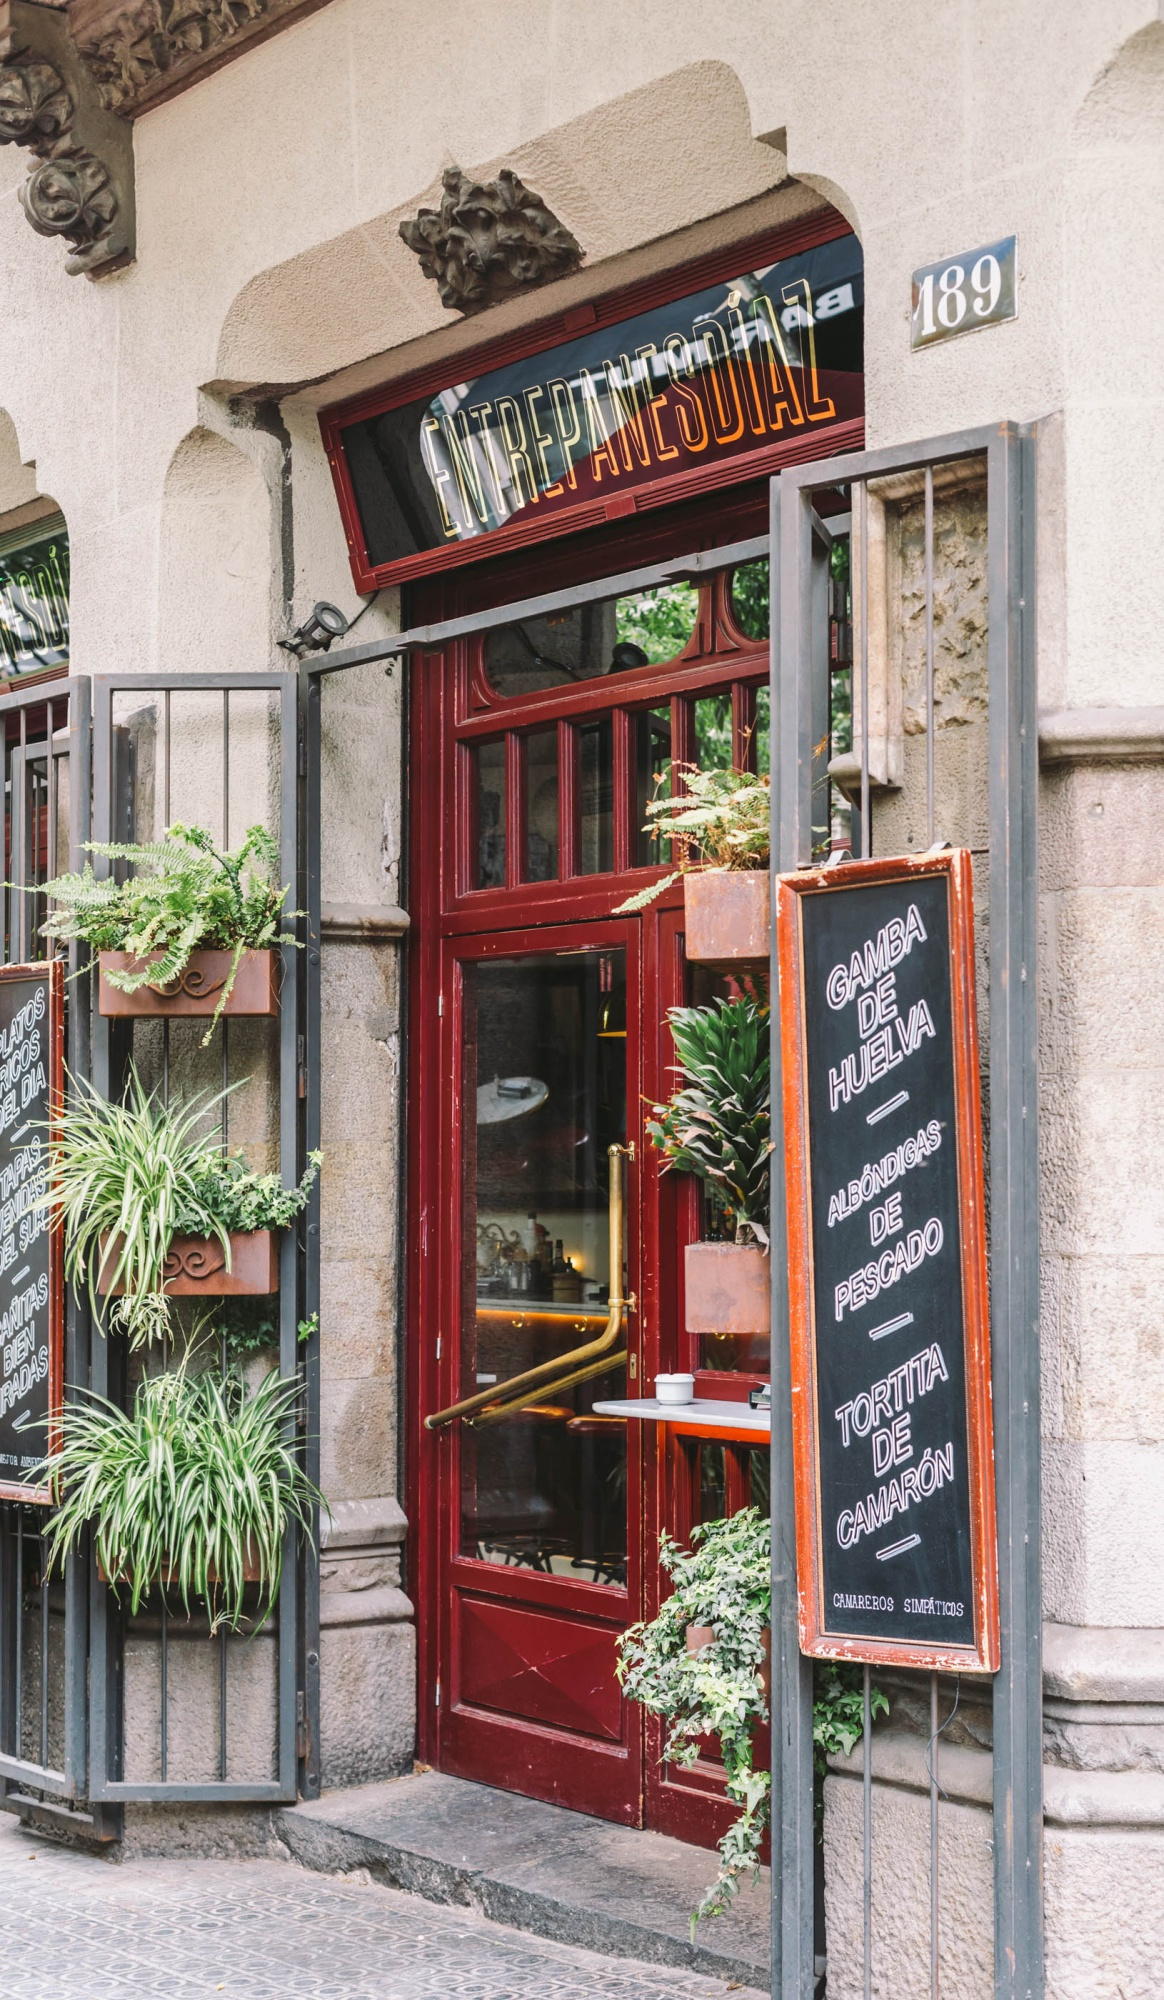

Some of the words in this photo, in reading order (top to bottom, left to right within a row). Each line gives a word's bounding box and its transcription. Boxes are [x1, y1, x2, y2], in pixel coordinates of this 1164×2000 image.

[913, 254, 1002, 336] 189
[825, 904, 928, 1011] GAMBA
[0, 987, 45, 1059] LATOS
[857, 972, 898, 1039] DE
[828, 999, 937, 1112] HUELVA
[0, 1165, 46, 1240] ENIDAS
[826, 1119, 943, 1227] ALBÓNDIGAS
[869, 1191, 903, 1247] DE
[833, 1217, 944, 1322] PESCADO
[0, 1273, 48, 1346] AÑITAS
[4, 1320, 35, 1378] BIEN
[835, 1342, 950, 1448] TORTITA
[871, 1412, 913, 1477] DE
[836, 1442, 955, 1550] CAMARÓN
[833, 1593, 894, 1611] CAMAREROS
[903, 1597, 965, 1616] SIMPÁTICOS
